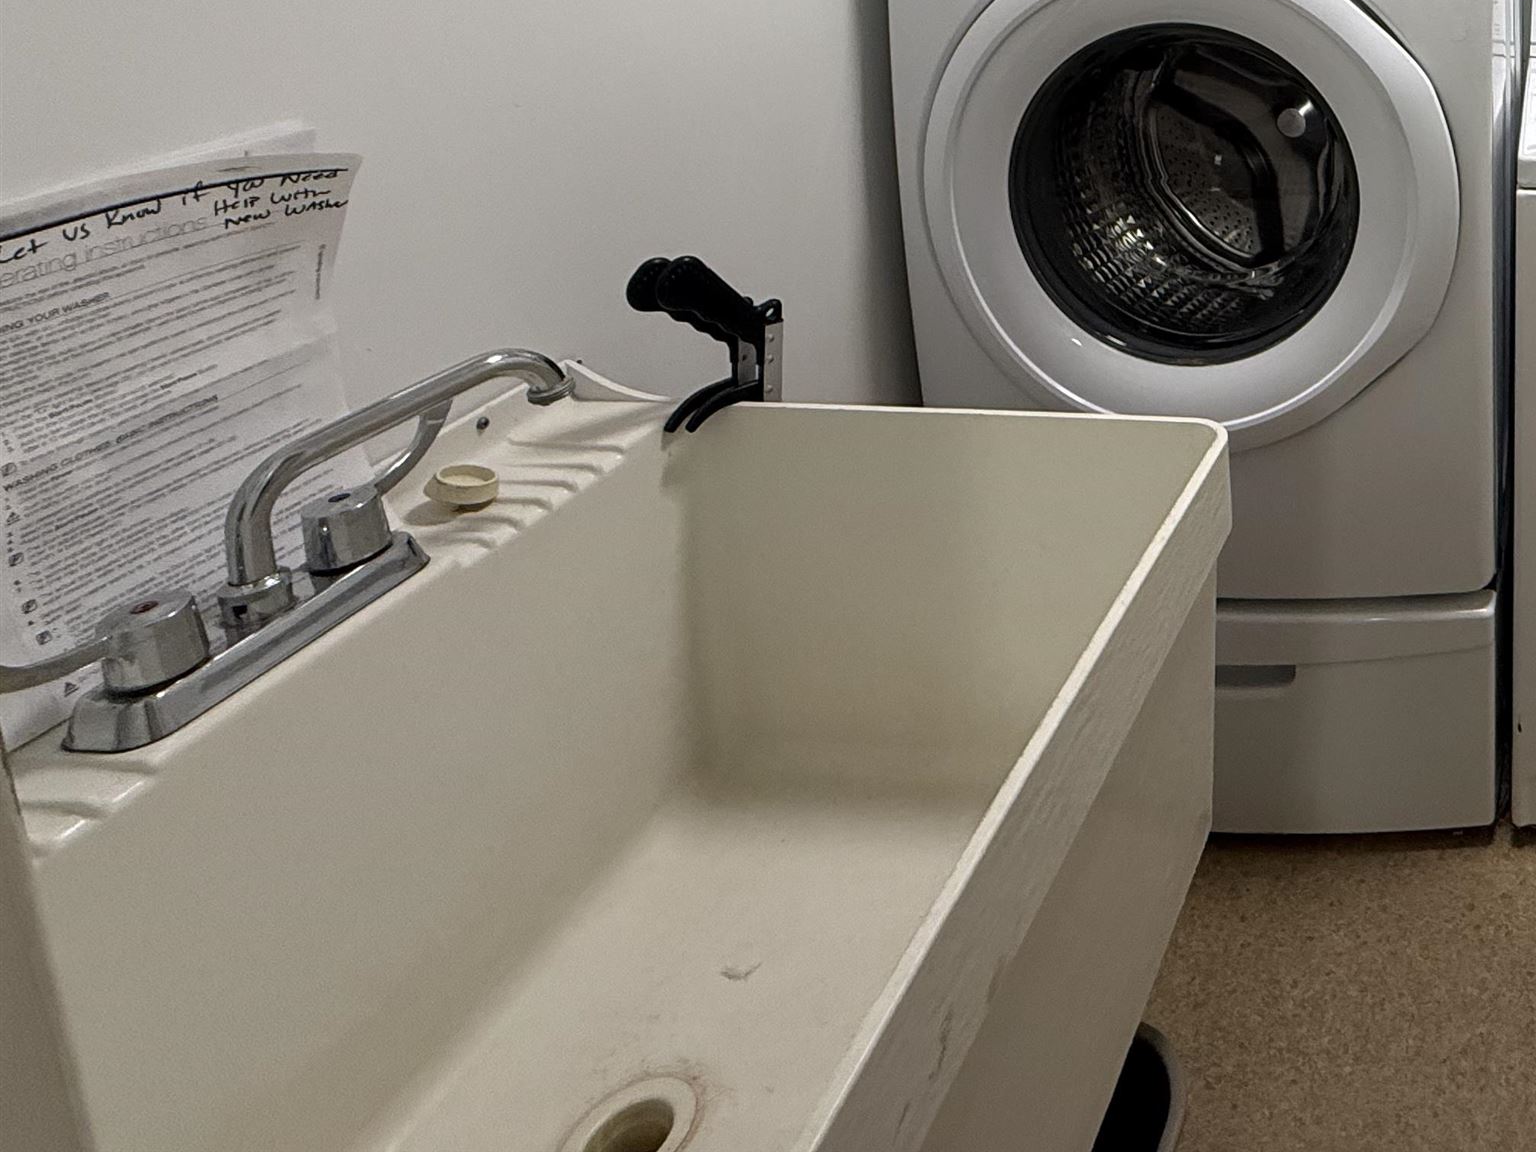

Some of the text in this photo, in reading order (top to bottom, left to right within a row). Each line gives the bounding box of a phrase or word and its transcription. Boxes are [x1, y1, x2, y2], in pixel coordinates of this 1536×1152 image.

[27, 308, 60, 323] YOUR
[3, 440, 111, 492] WASHING CLOTHES
